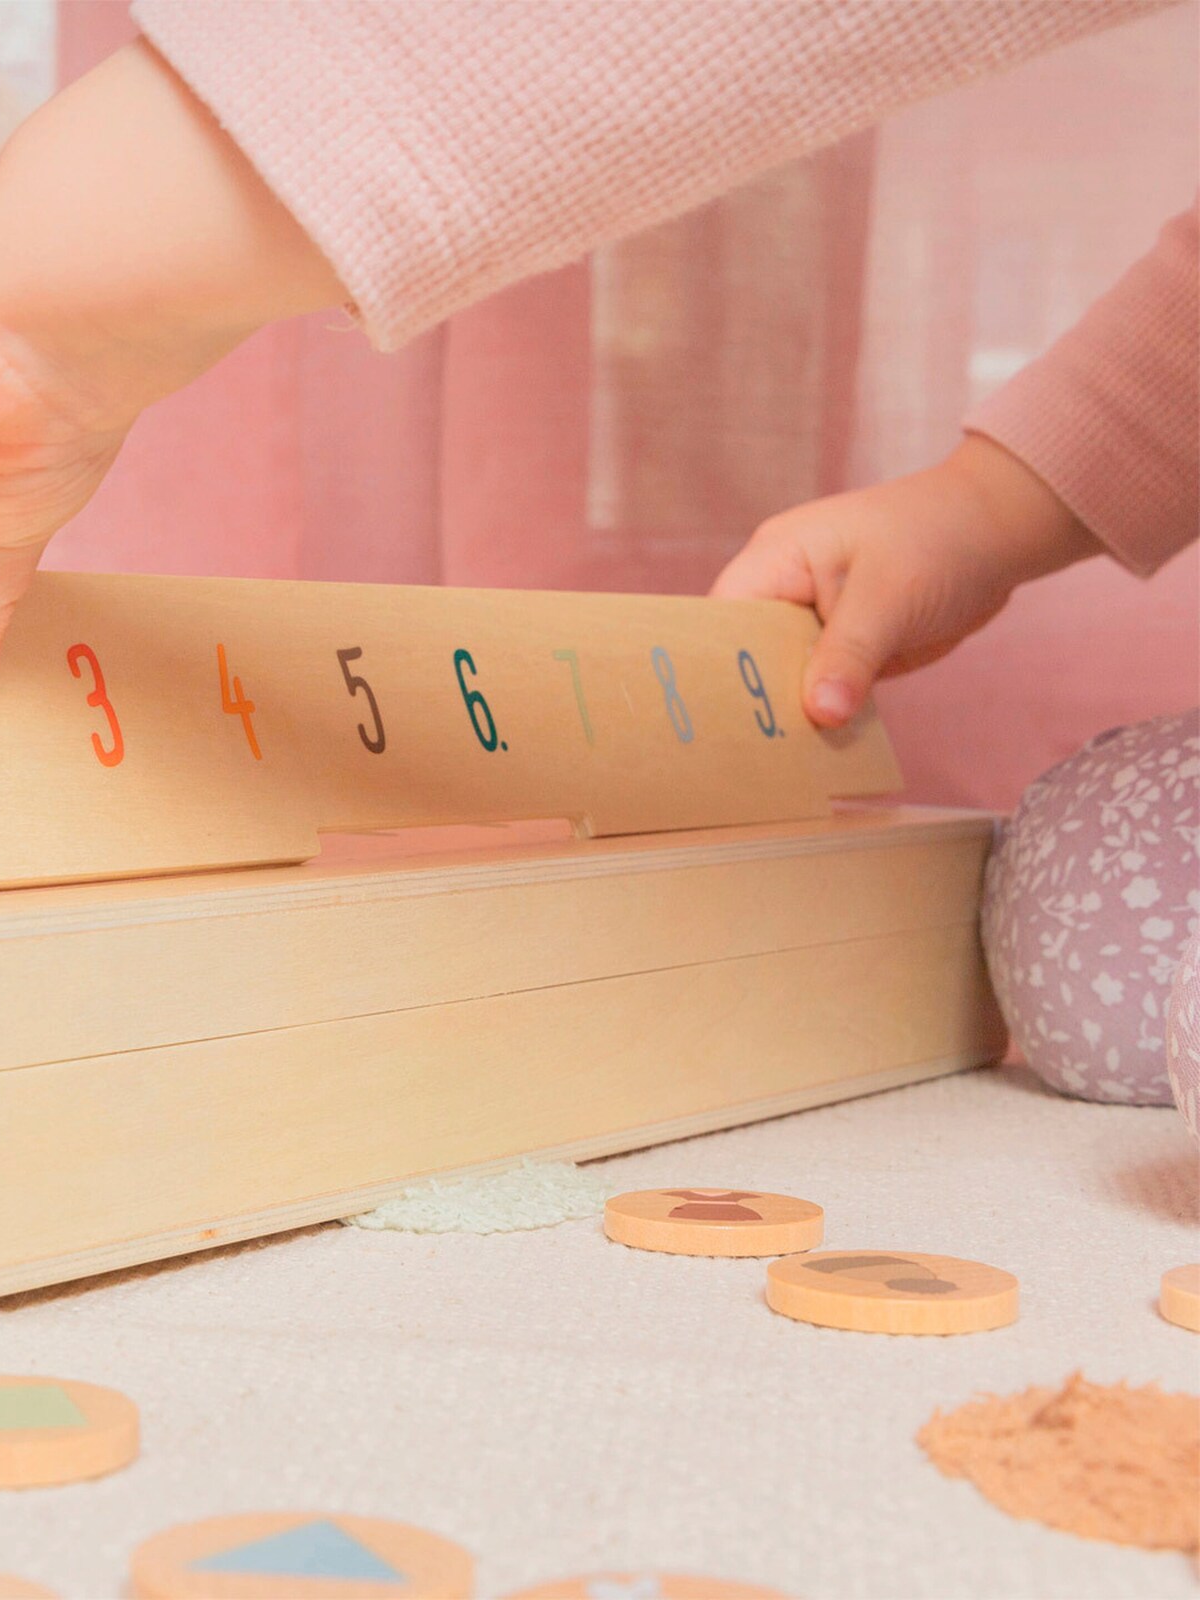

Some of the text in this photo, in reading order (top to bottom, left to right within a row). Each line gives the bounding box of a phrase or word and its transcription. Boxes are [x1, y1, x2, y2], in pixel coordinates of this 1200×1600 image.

[66, 642, 125, 768] 3
[216, 642, 263, 761] 4
[336, 645, 386, 755] 5
[551, 648, 596, 749] 7
[650, 645, 694, 744] 8
